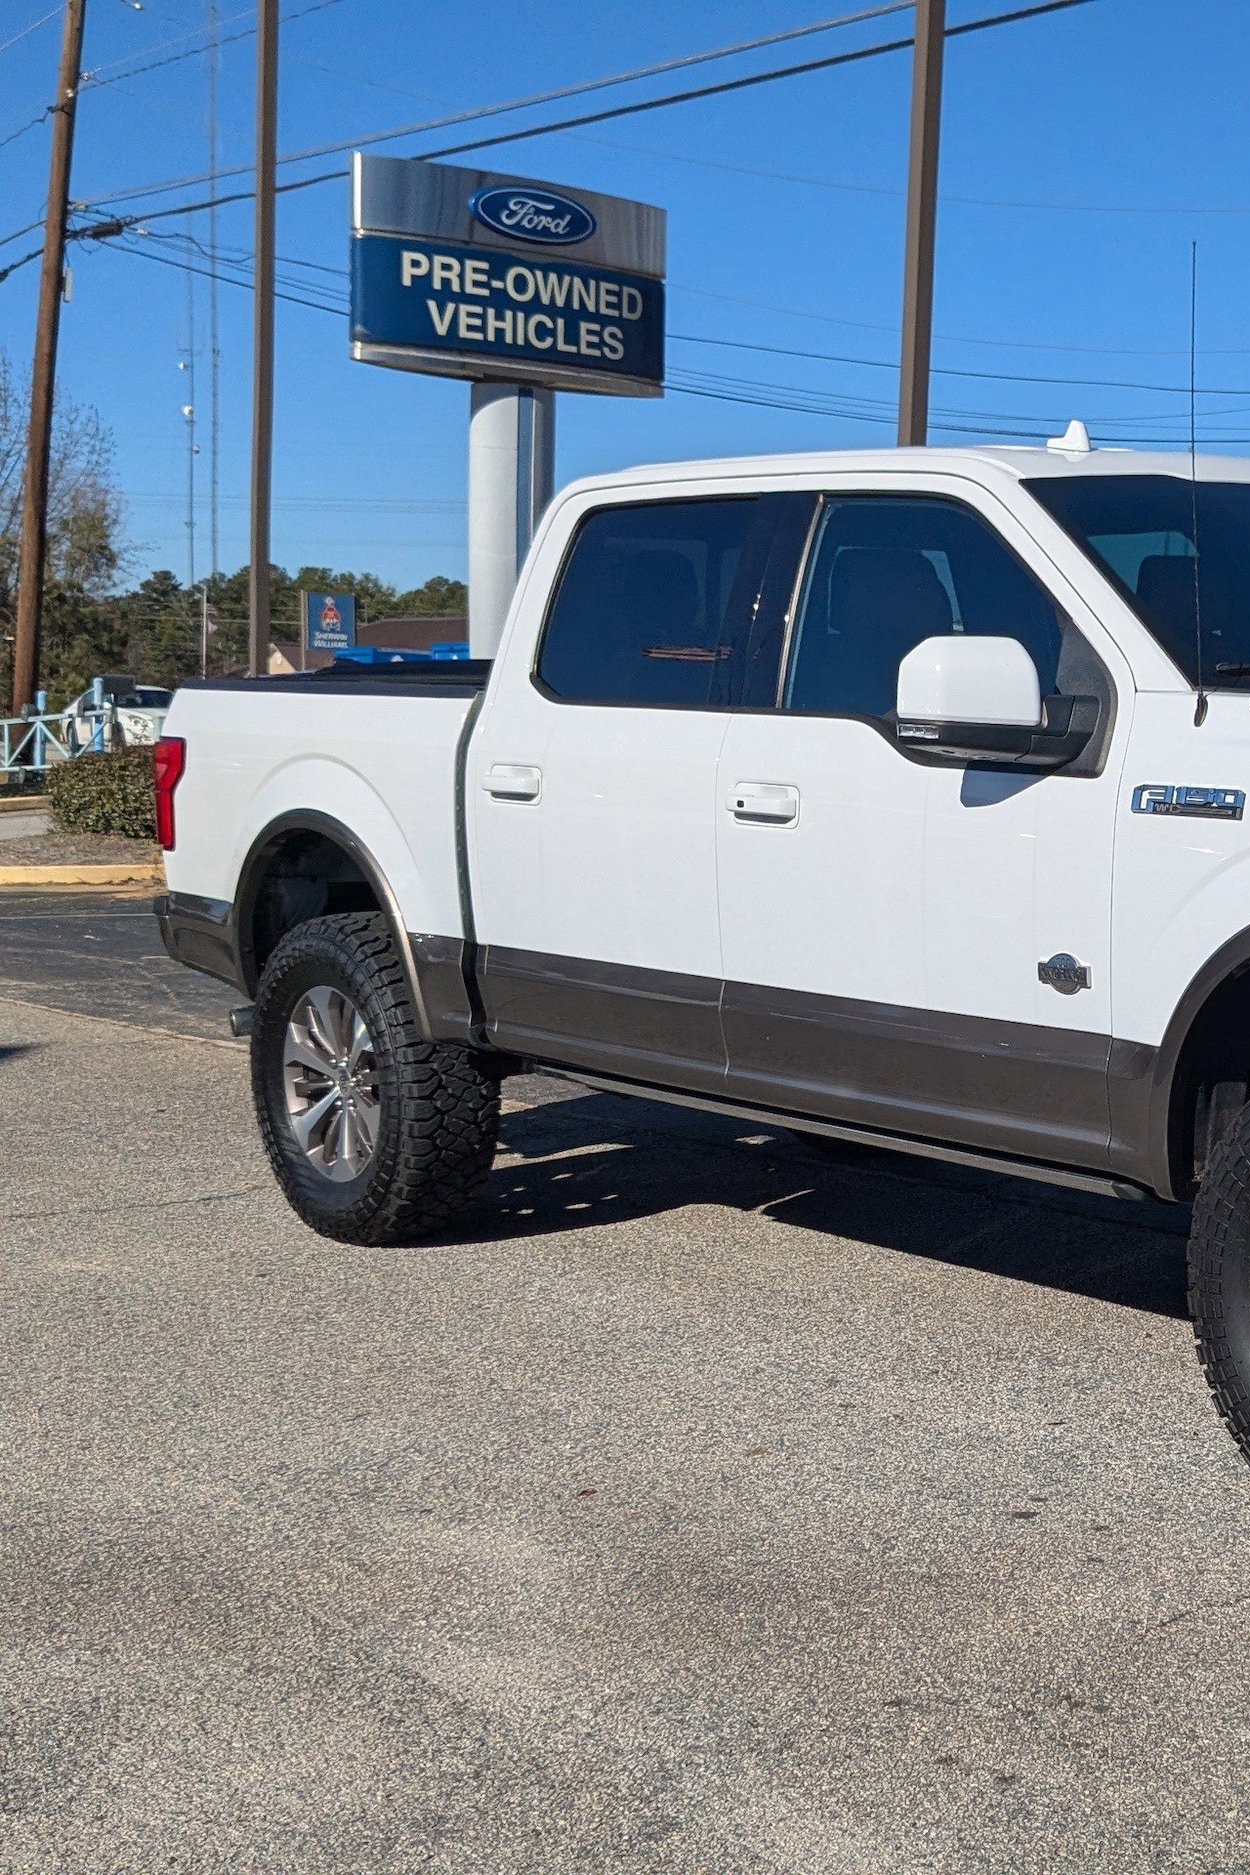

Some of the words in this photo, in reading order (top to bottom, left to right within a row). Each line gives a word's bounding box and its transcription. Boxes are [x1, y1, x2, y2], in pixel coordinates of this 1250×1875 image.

[500, 196, 570, 236] Ford
[401, 251, 644, 321] PRE-OWNED
[426, 300, 625, 362] VEHICLES
